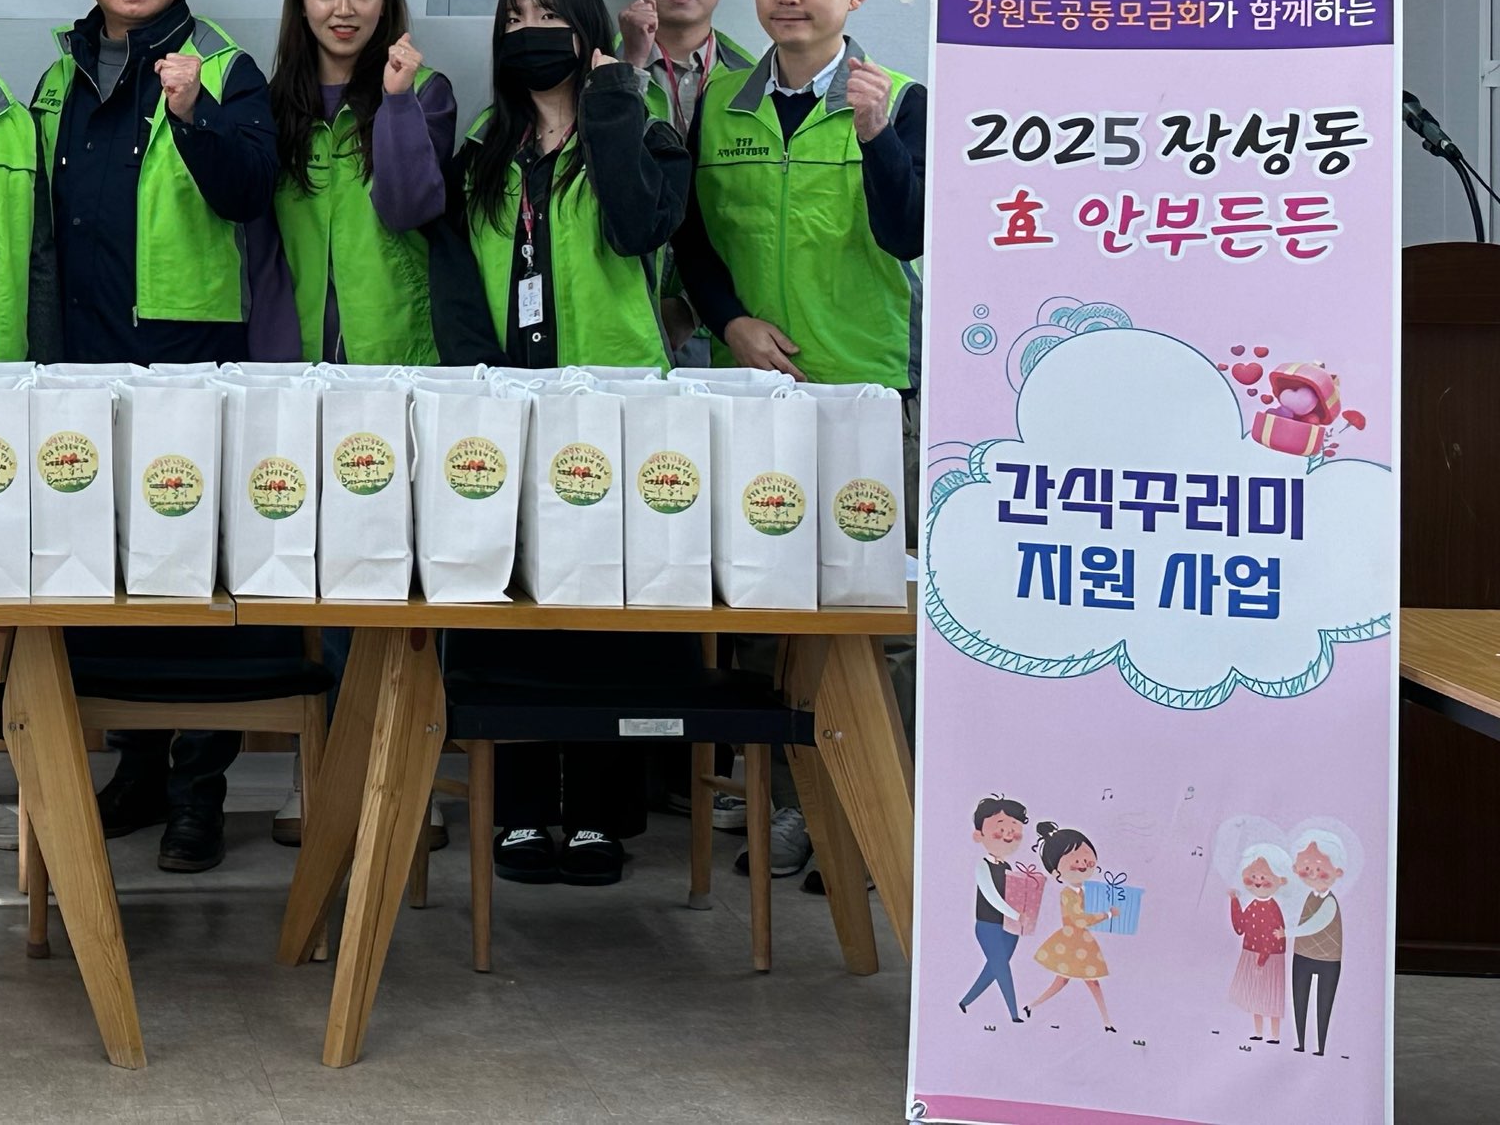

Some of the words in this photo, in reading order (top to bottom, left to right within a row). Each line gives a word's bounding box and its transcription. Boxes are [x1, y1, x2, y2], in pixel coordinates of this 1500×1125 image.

[967, 114, 1140, 166] 2025
[1161, 111, 1368, 175] 장성동
[993, 189, 1053, 246] 효
[1079, 195, 1338, 258] 안부든든
[996, 462, 1304, 540] 간식꾸러미
[1017, 542, 1135, 610] 지원
[1158, 552, 1280, 620] 사업
